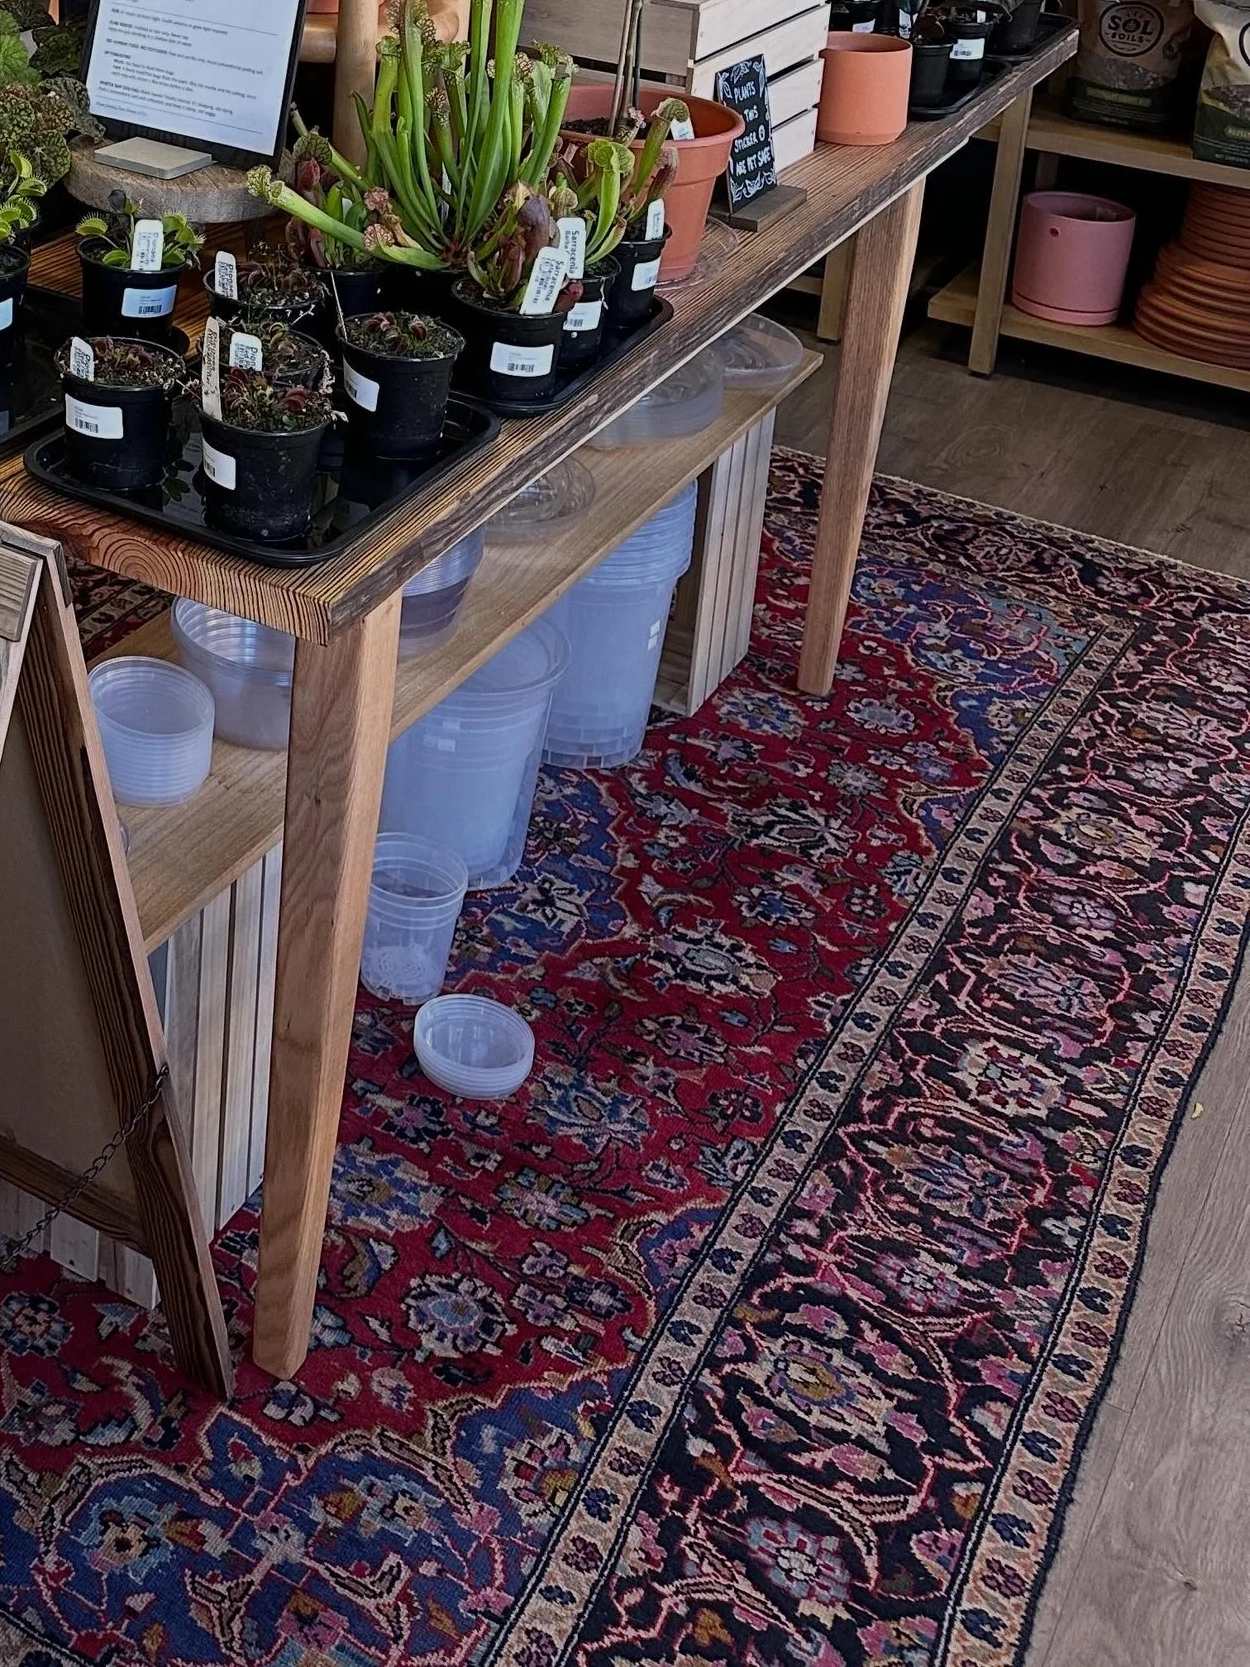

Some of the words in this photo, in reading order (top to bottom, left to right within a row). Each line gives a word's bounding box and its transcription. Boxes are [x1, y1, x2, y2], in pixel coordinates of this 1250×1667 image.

[1108, 15, 1154, 35] SOL
[1111, 32, 1144, 43] SOILS
[734, 80, 756, 104] PLANTS
[734, 132, 757, 153] STICKER
[735, 159, 747, 177] ARE
[747, 152, 758, 173] PET
[757, 145, 772, 168] SAFE
[568, 230, 580, 274] Sarracenia
[545, 260, 565, 302] Sarracenia
